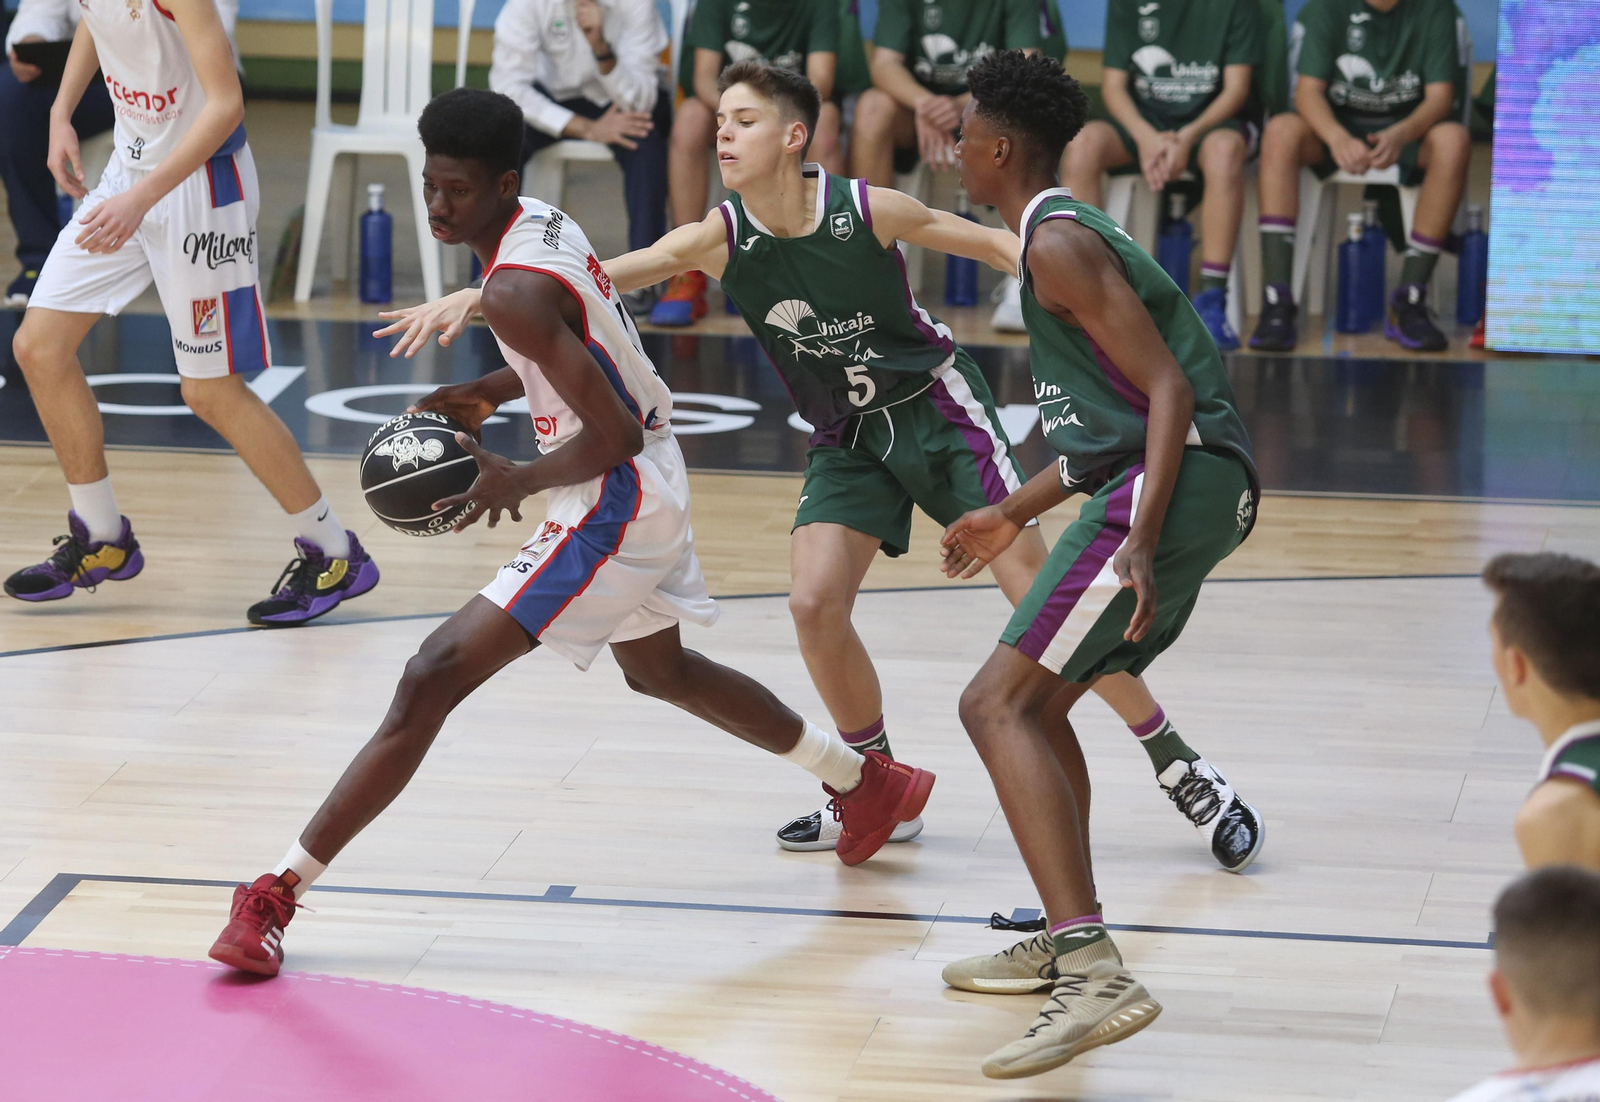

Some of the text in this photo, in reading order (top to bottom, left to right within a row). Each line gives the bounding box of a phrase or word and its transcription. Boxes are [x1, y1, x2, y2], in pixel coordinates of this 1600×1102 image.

[816, 311, 875, 337] Unicaja
[174, 339, 223, 354] MONBUS
[844, 364, 876, 407] 5
[394, 499, 479, 537] SPALDING
